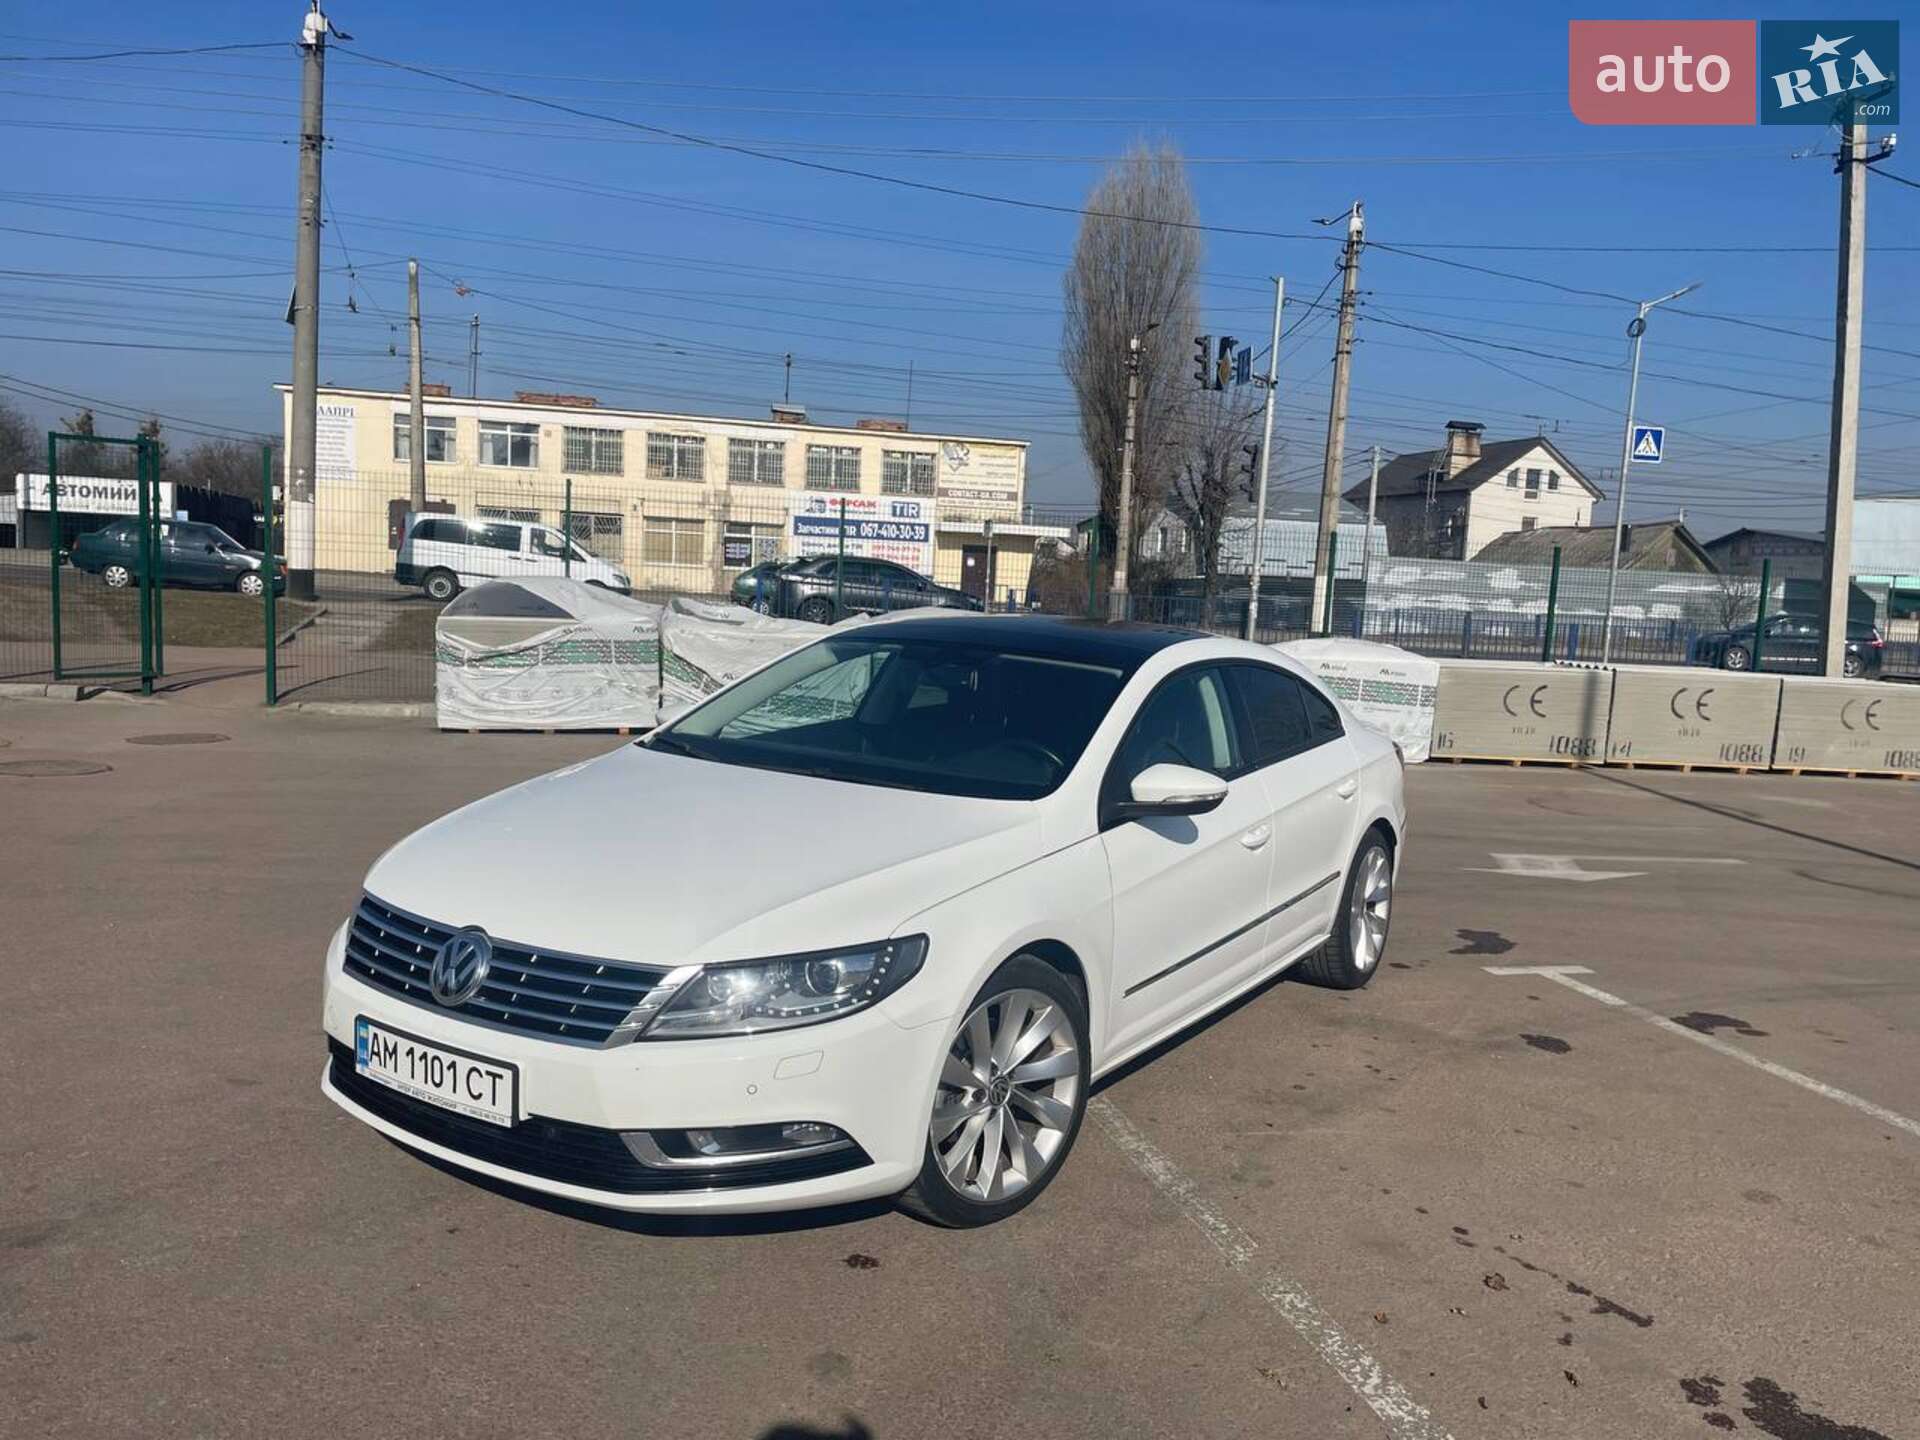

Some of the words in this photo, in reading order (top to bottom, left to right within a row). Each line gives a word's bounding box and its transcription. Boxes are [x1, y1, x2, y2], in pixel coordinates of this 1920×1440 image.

[893, 503, 918, 517] TIR
[861, 523, 925, 540] 067-410-30-39
[1503, 684, 1548, 718] CE
[1670, 687, 1715, 721] CE
[1840, 698, 1882, 731] CE
[369, 1032, 398, 1073] AM
[405, 1046, 457, 1095] 1101
[466, 1066, 503, 1106] CT
